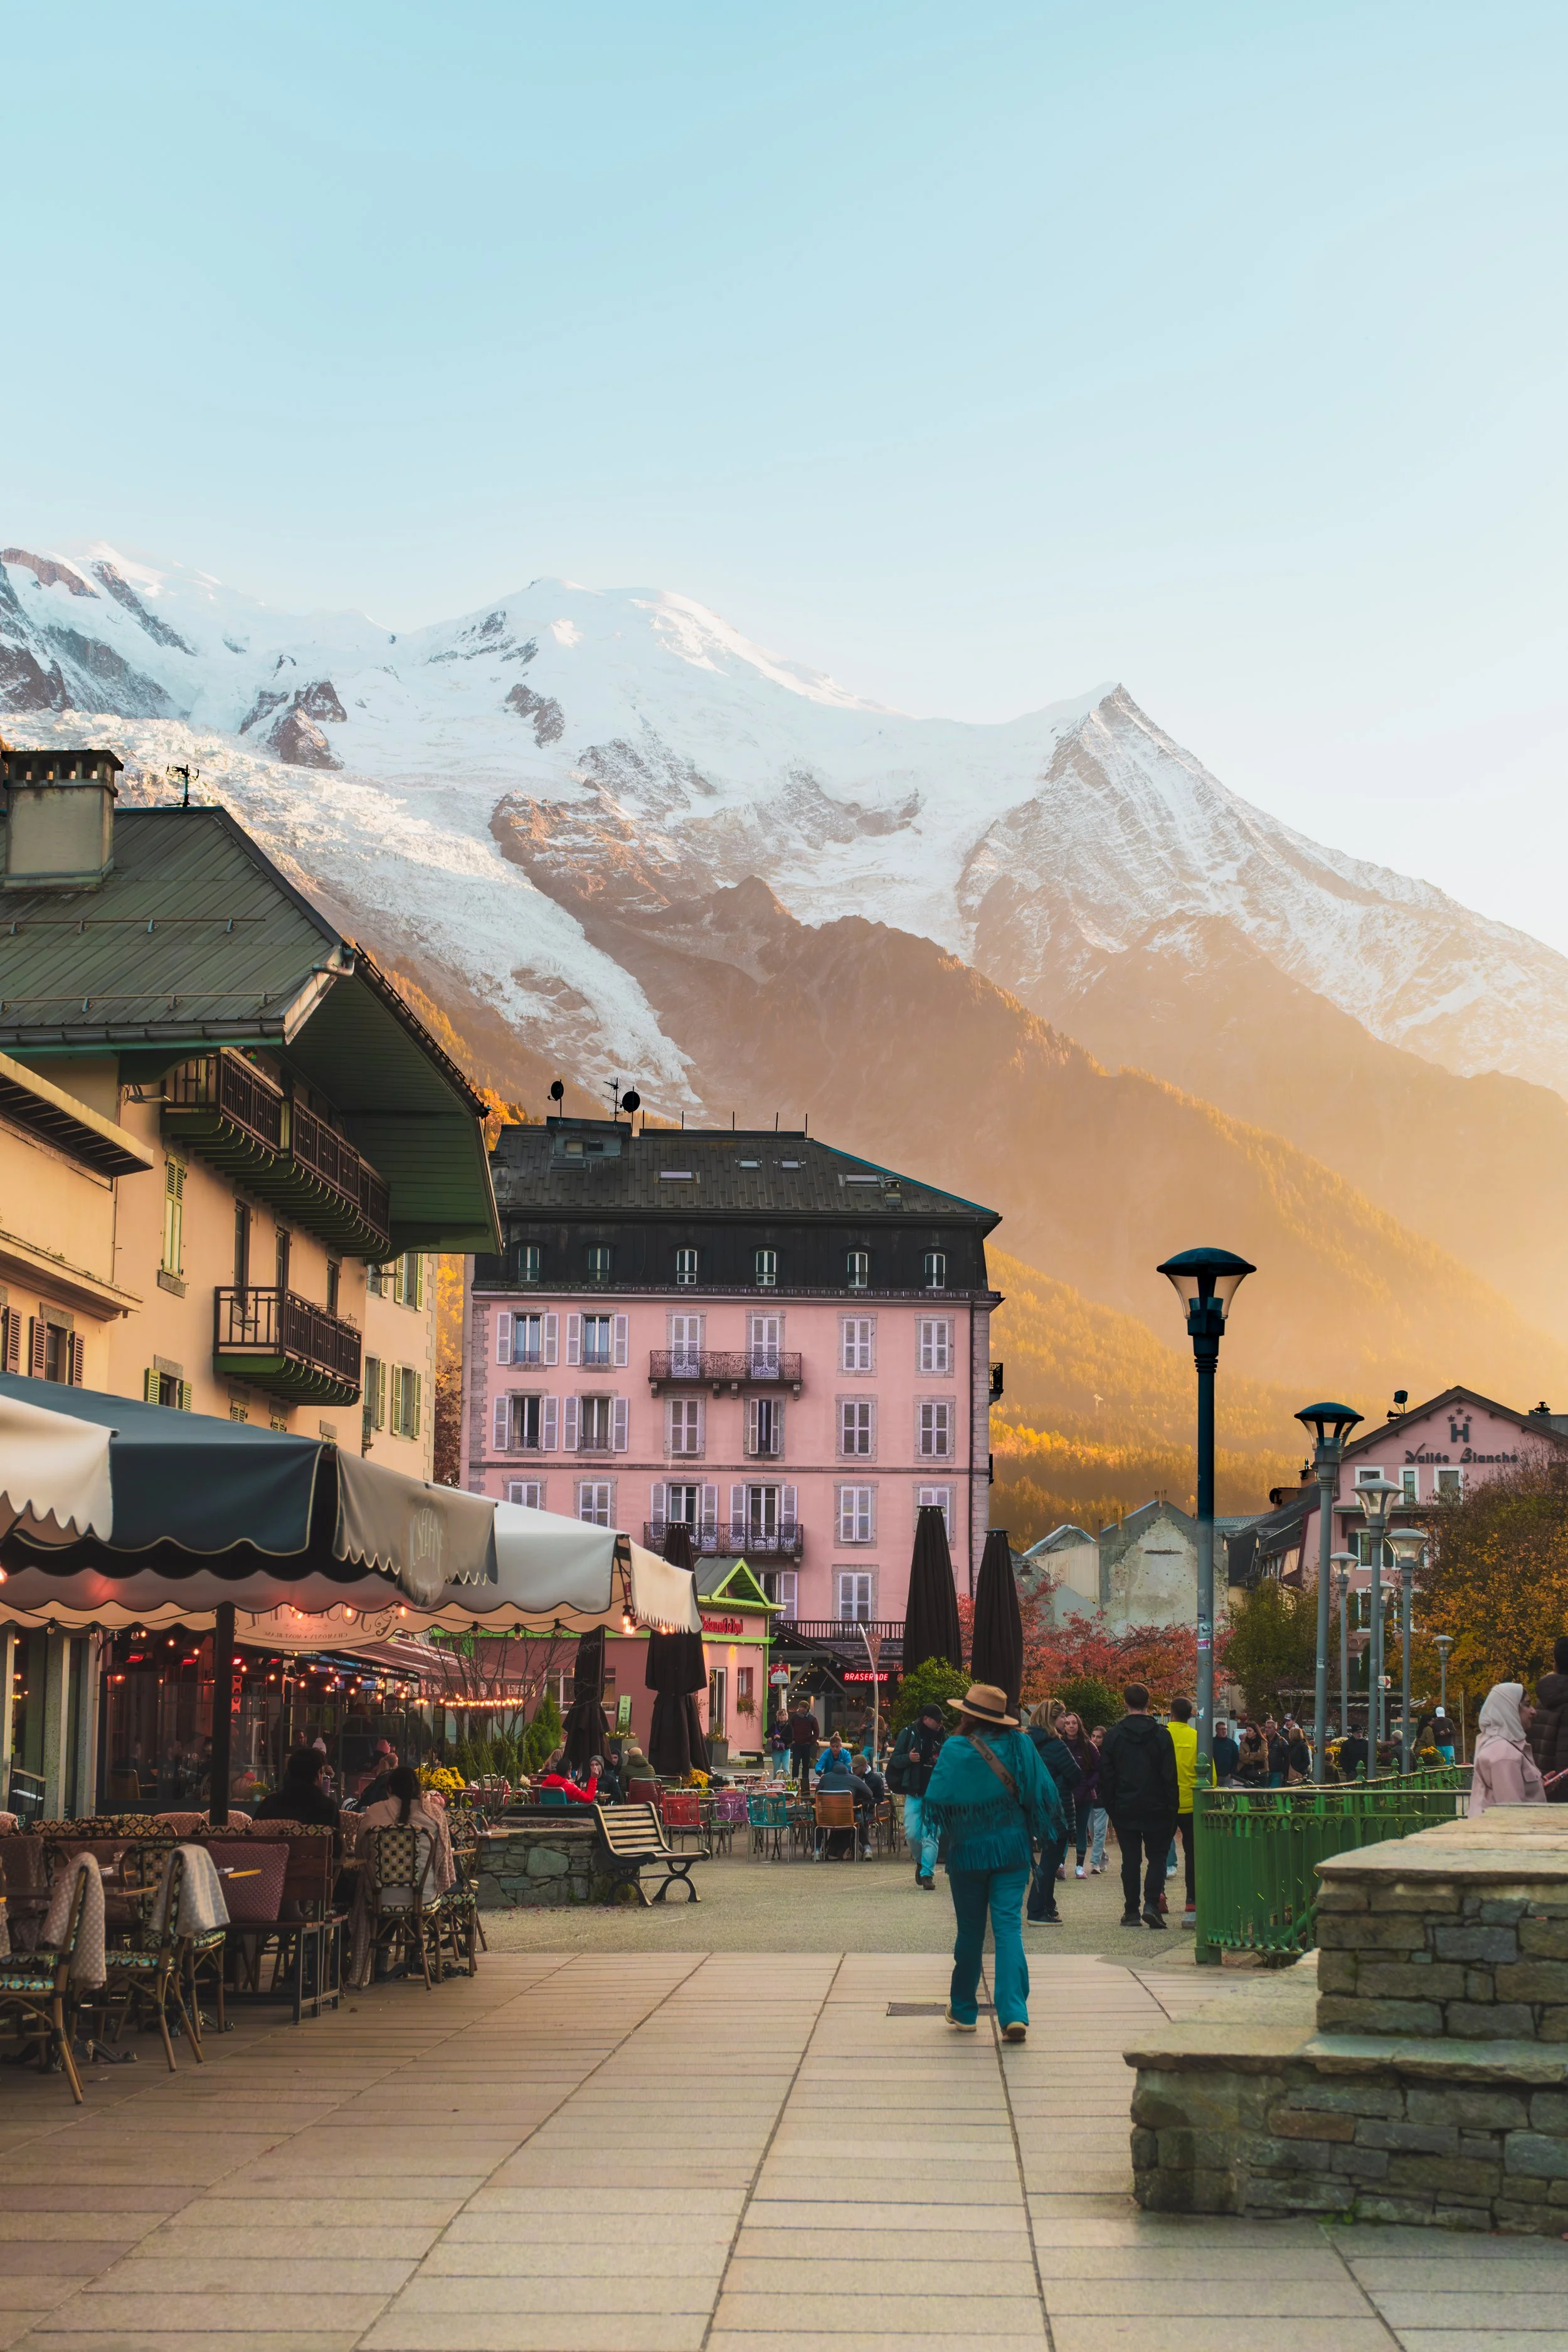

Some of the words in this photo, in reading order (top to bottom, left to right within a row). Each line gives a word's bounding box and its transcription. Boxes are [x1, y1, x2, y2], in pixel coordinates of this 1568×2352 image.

[1451, 1423, 1470, 1443] H
[1405, 1443, 1450, 1464] Vallée
[1459, 1447, 1518, 1463] Blanche
